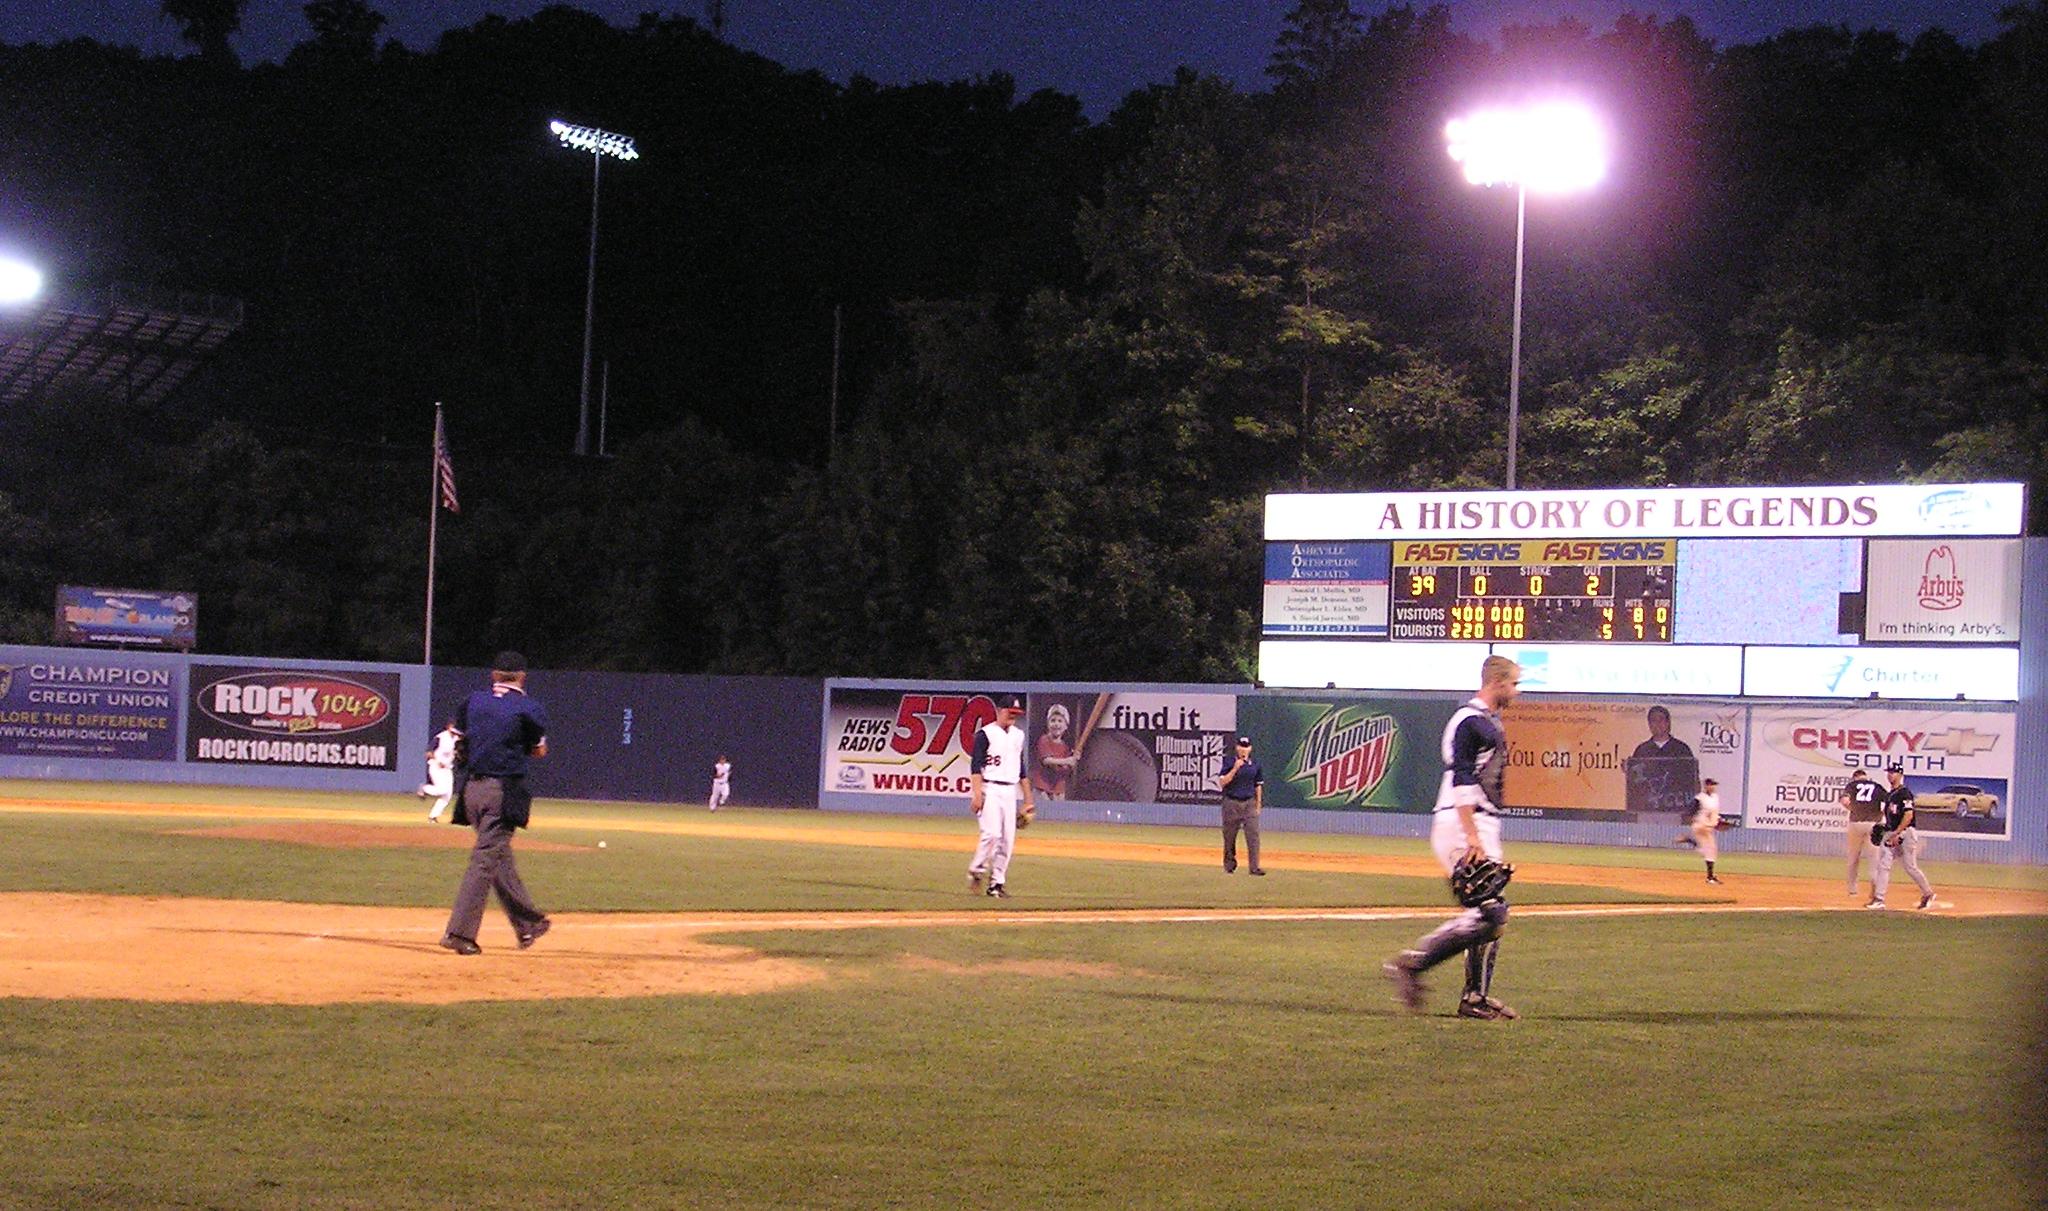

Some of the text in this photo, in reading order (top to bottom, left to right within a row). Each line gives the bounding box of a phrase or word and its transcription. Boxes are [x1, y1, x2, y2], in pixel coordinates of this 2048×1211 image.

[1378, 496, 1878, 530] A HISTORY OF LEGENDS
[1404, 543, 1522, 561] FASTSIGNS
[1543, 542, 1666, 561] FASTSIGNS
[1409, 566, 1438, 576] AT BAT
[1469, 566, 1492, 576] BALL
[1520, 566, 1552, 576] STRIKE
[1583, 566, 1602, 576] OUT
[1411, 575, 1436, 596] 39
[1474, 575, 1487, 596] 0
[1530, 575, 1543, 596] 0
[1586, 575, 1600, 596] 2
[1396, 608, 1445, 621] VISITORS
[1602, 608, 1614, 622] 4
[1656, 607, 1667, 623] 0
[1394, 624, 1446, 637] TOURISTS
[1602, 623, 1613, 640] 5
[1660, 625, 1667, 640] 1
[1879, 622, 2006, 636] I'm thinking Arby's.
[30, 664, 169, 685] CHAMPION
[29, 690, 169, 708] CREDIT UNION
[214, 683, 381, 717] ROCK 104.9
[44, 713, 73, 725] THE
[77, 714, 168, 729] DIFFERENCE
[843, 718, 892, 736] NEWS
[889, 694, 998, 757] 570
[1113, 705, 1200, 730] find it
[838, 735, 886, 753] RADIO
[1156, 735, 1202, 754] Biltmore
[1700, 721, 1741, 749] TCCU
[1792, 727, 1928, 752] CHEVY
[199, 737, 387, 766] ROCK104ROCKS.COM
[1300, 717, 1392, 773] Mountain
[986, 754, 1001, 767] 26
[1162, 754, 1201, 776] Baptist
[1505, 741, 1619, 776] You can join!
[1844, 753, 1945, 770] SOUTH
[1160, 772, 1201, 791] Church
[1807, 775, 1821, 785] AN
[1855, 783, 1876, 802] 27
[1766, 805, 1848, 816] Hendersonville
